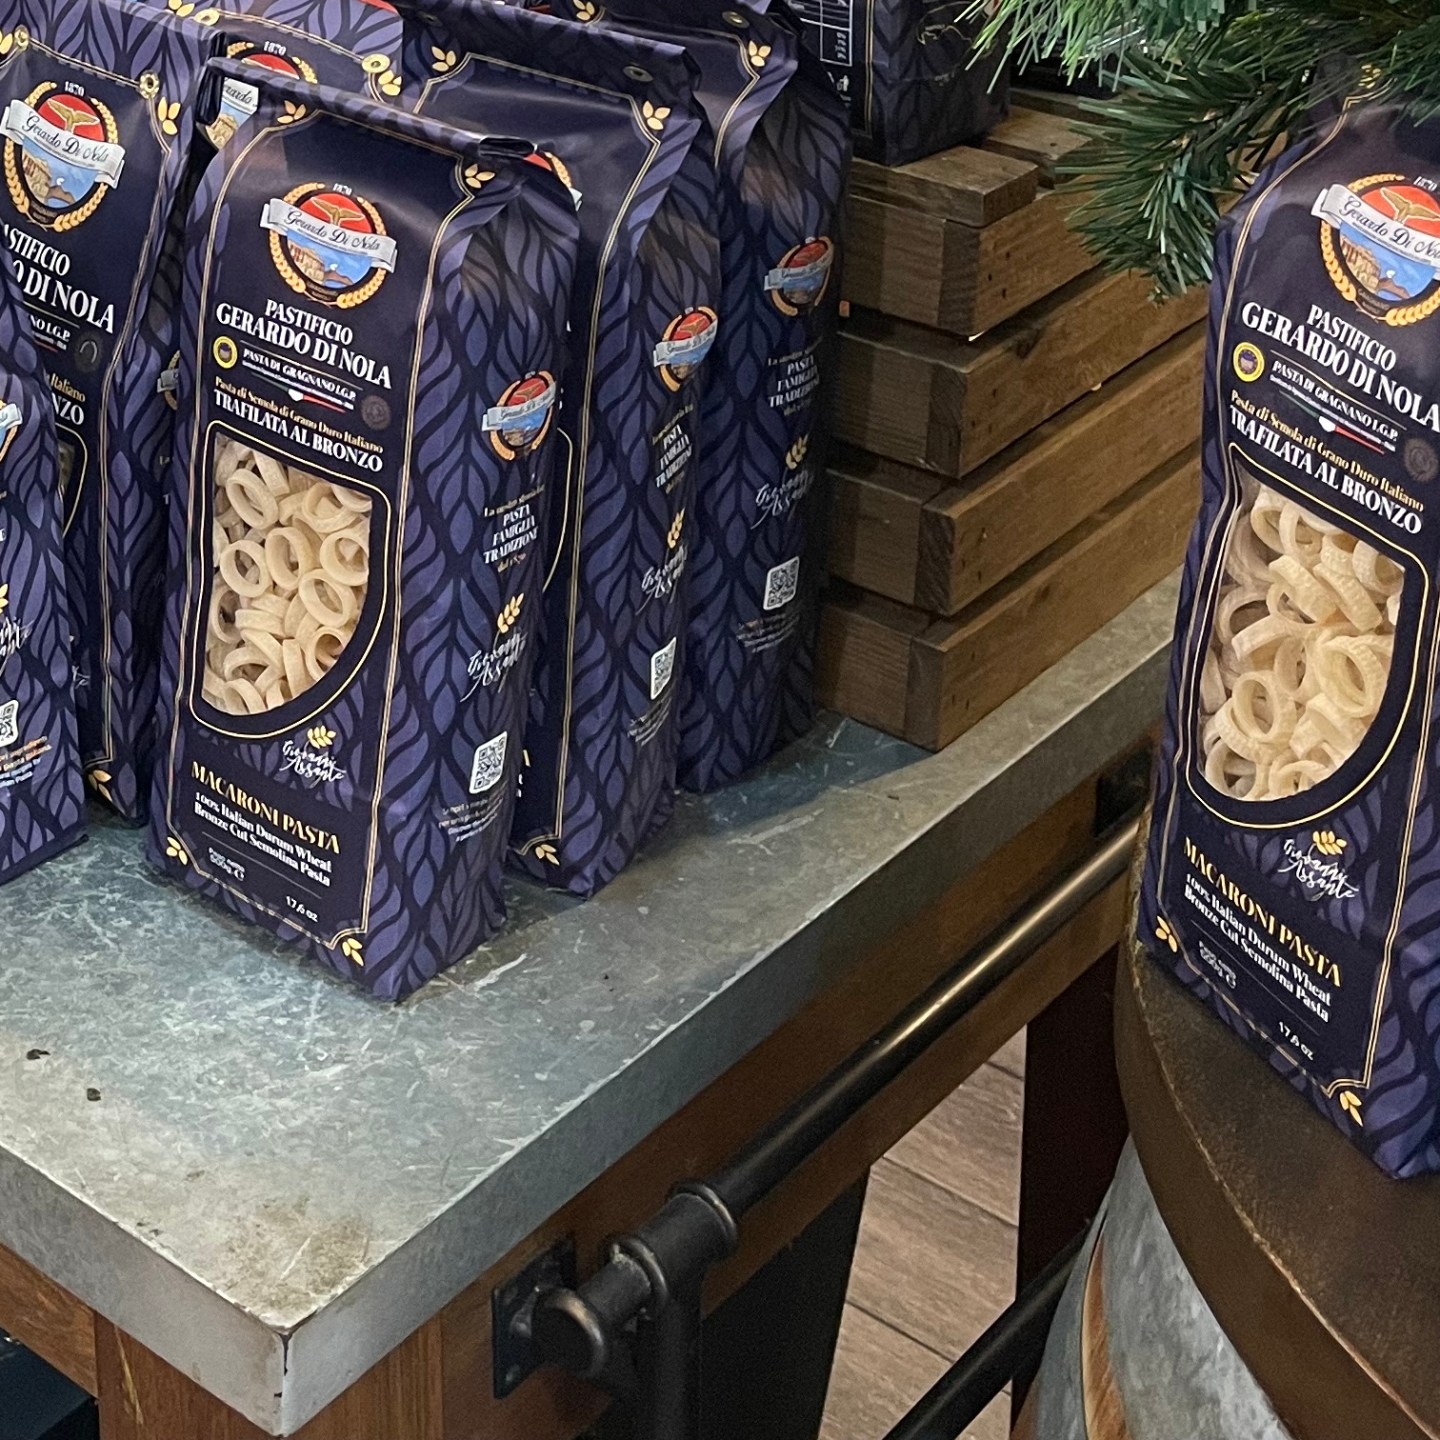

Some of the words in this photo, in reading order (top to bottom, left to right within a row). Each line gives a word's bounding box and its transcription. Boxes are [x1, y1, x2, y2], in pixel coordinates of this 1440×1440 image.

[263, 40, 287, 55] 1870
[63, 80, 85, 96] 1870
[20, 113, 63, 151] Gerardo
[62, 138, 81, 155] Di
[332, 182, 353, 196] 1870
[1413, 175, 1438, 192] 1870
[283, 208, 327, 239] Gerardo
[328, 228, 351, 245] Di
[1339, 195, 1389, 238] Gerardo
[1391, 224, 1415, 249] Di
[27, 270, 48, 303] DI
[56, 280, 115, 335] NOLA
[265, 298, 353, 345] PASTIFICIO
[216, 302, 310, 361] GERARDO
[311, 340, 337, 367] DI
[340, 349, 392, 390] NOLA
[1307, 304, 1397, 373] PASTIFICIO
[282, 364, 334, 393] GRAGNANO
[1241, 301, 1350, 379] GERARDO
[1348, 360, 1376, 398] DI
[1376, 376, 1440, 434] NOLA
[213, 389, 290, 439] TRAFILATA
[289, 423, 310, 448] AL
[312, 434, 383, 473] BRONZO
[343, 428, 384, 453] Italiano
[1229, 405, 1315, 474] TRAFILATA
[1315, 461, 1339, 491] AL
[1341, 471, 1422, 535] BRONZO
[191, 761, 279, 826] MACARONI
[283, 814, 340, 855] PASTA
[249, 834, 298, 871] Semolina
[300, 860, 331, 887] Pasta
[256, 823, 294, 854] Durum
[295, 844, 332, 873] Wheat
[1183, 835, 1277, 935] MACARONI
[1279, 926, 1342, 988] PASTA
[1292, 962, 1332, 1007] Wheat
